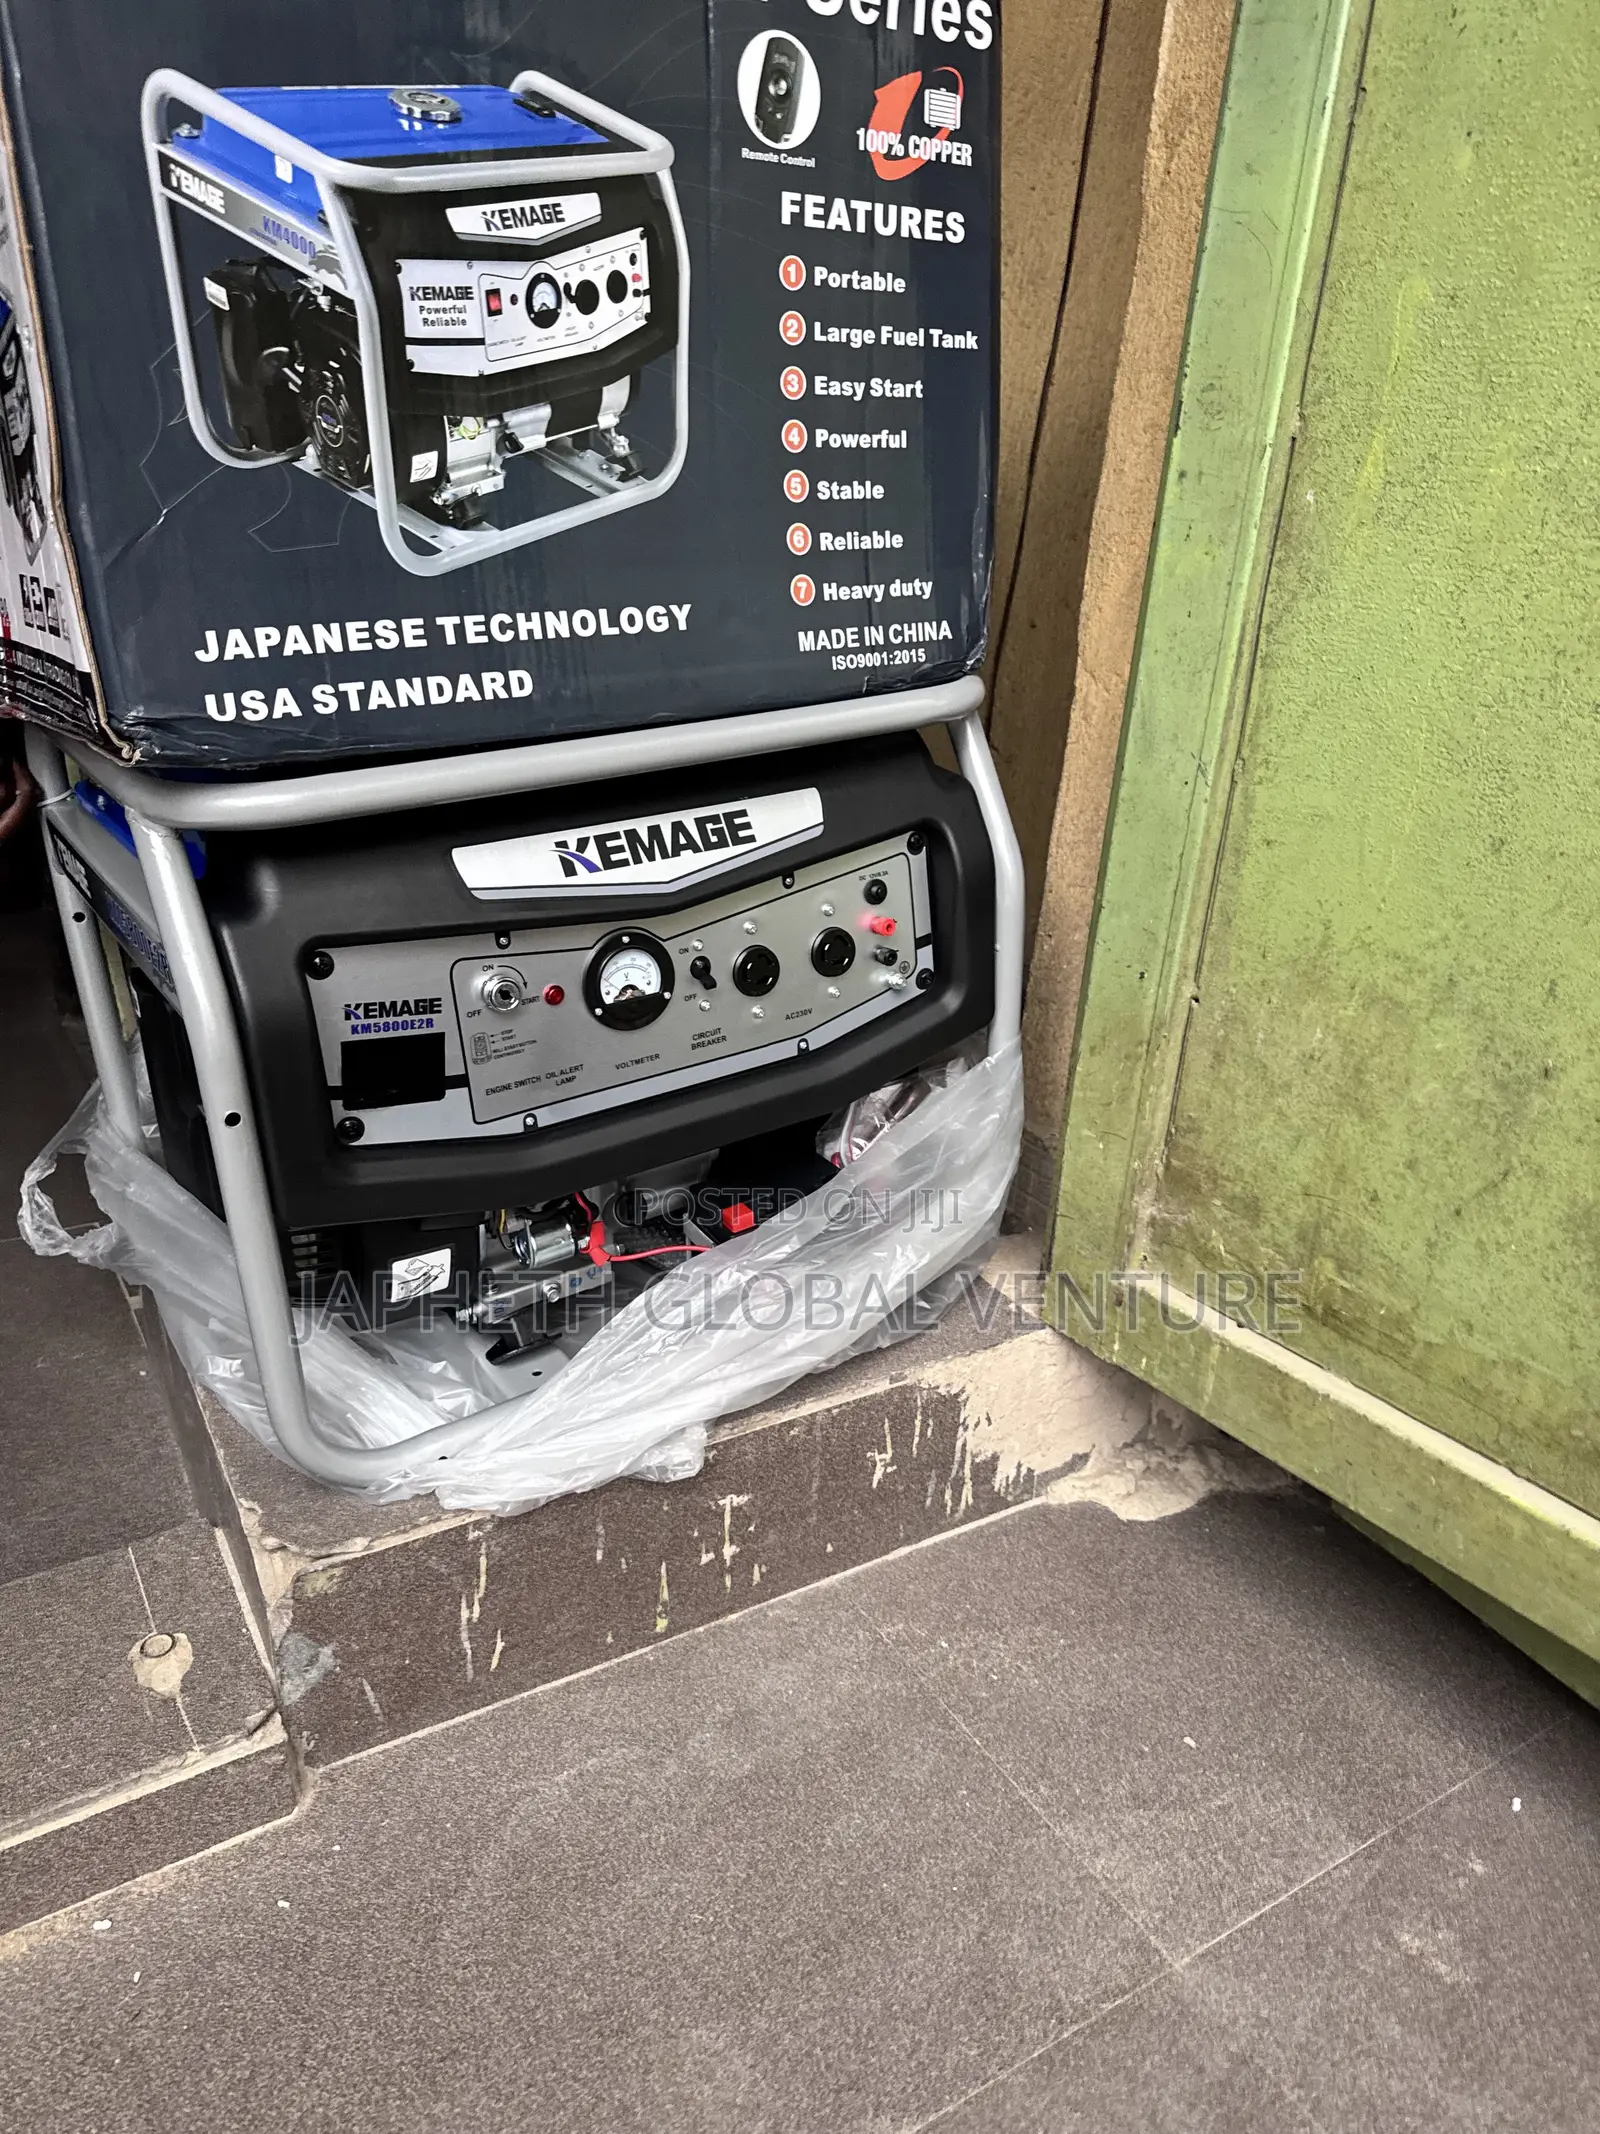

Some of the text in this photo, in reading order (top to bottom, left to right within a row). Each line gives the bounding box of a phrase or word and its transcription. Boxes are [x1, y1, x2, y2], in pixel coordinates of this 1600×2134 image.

[741, 148, 816, 168] Remote Control
[856, 128, 973, 167] 100% COPPER
[480, 202, 566, 232] KEMAGE
[781, 191, 966, 244] FEATURES
[262, 215, 317, 259] KM4000
[813, 266, 907, 293] Portable
[409, 286, 475, 302] KEMAGE
[418, 304, 468, 317] Powerful
[422, 317, 468, 328] Reliable
[813, 322, 876, 348] Large
[880, 325, 924, 347] Fuel
[929, 328, 979, 350] Tank
[814, 375, 866, 401] Easy
[869, 377, 924, 399] Start
[815, 428, 908, 449] Powerful
[816, 480, 885, 501] Stable
[819, 530, 904, 551] Reliable
[822, 582, 886, 603] Heavy
[889, 578, 934, 600] duty
[194, 603, 693, 663] JAPANESE TECHNOLOGY
[797, 620, 953, 652] MADE IN CHINA
[831, 648, 927, 671] ISO9001:2015
[205, 668, 535, 723] USA STANDARD
[548, 808, 758, 878] KEMAGE
[678, 946, 690, 955] ON
[482, 964, 495, 972] ON
[521, 995, 540, 1007] START
[684, 993, 698, 1002] OFF
[341, 997, 443, 1021] KEMAGE
[466, 1009, 483, 1019] OFF
[785, 1008, 813, 1021] AC230V
[350, 1018, 435, 1036] KM5800E2R
[692, 1027, 723, 1042] CIRCUIT
[691, 1035, 728, 1051] BREAKER
[545, 1064, 584, 1080] OIL ALERT
[615, 1053, 661, 1071] VOLTMETER
[485, 1075, 542, 1096] ENGINE SWITCH
[555, 1075, 577, 1087] LAMP
